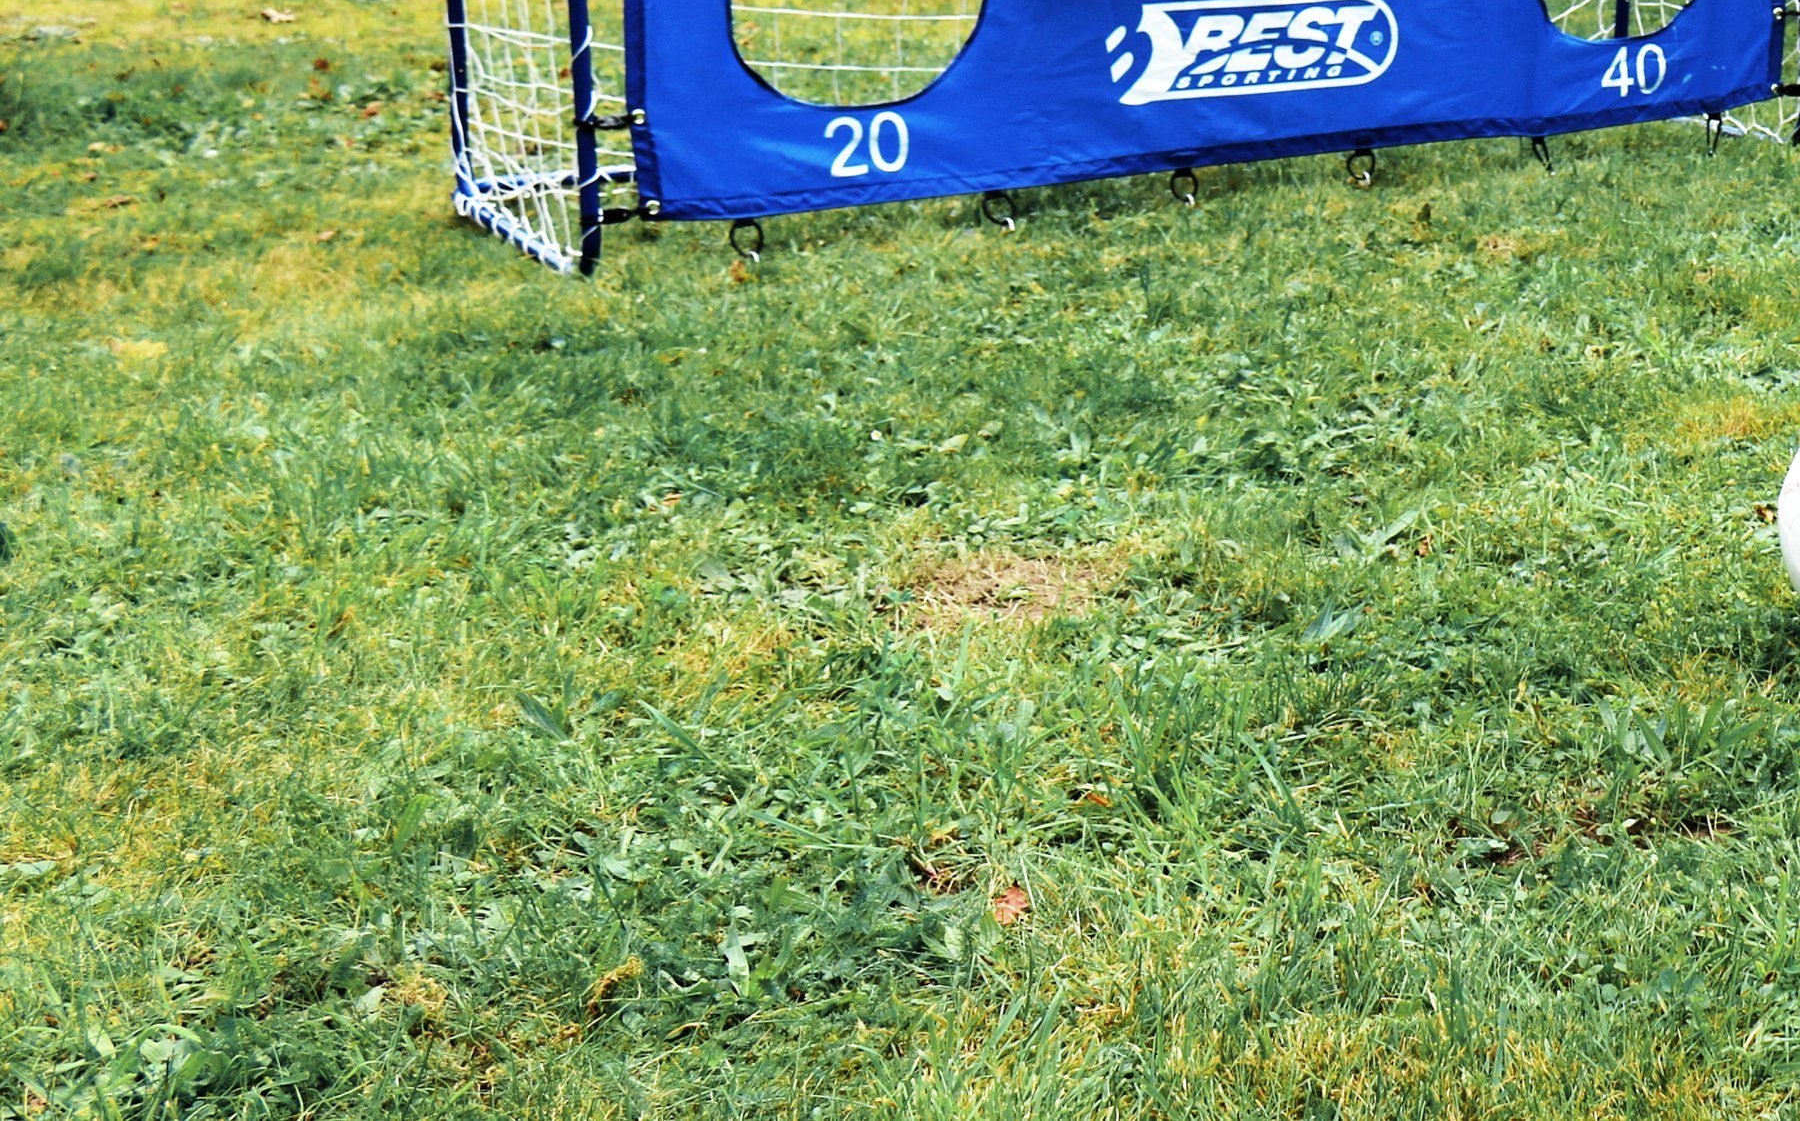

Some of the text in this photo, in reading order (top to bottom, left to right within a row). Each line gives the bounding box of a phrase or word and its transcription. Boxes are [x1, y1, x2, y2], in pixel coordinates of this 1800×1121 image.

[1184, 5, 1379, 75] BEST
[1601, 43, 1667, 97] 40
[1176, 65, 1342, 89] SPORTING
[825, 111, 909, 178] 20
